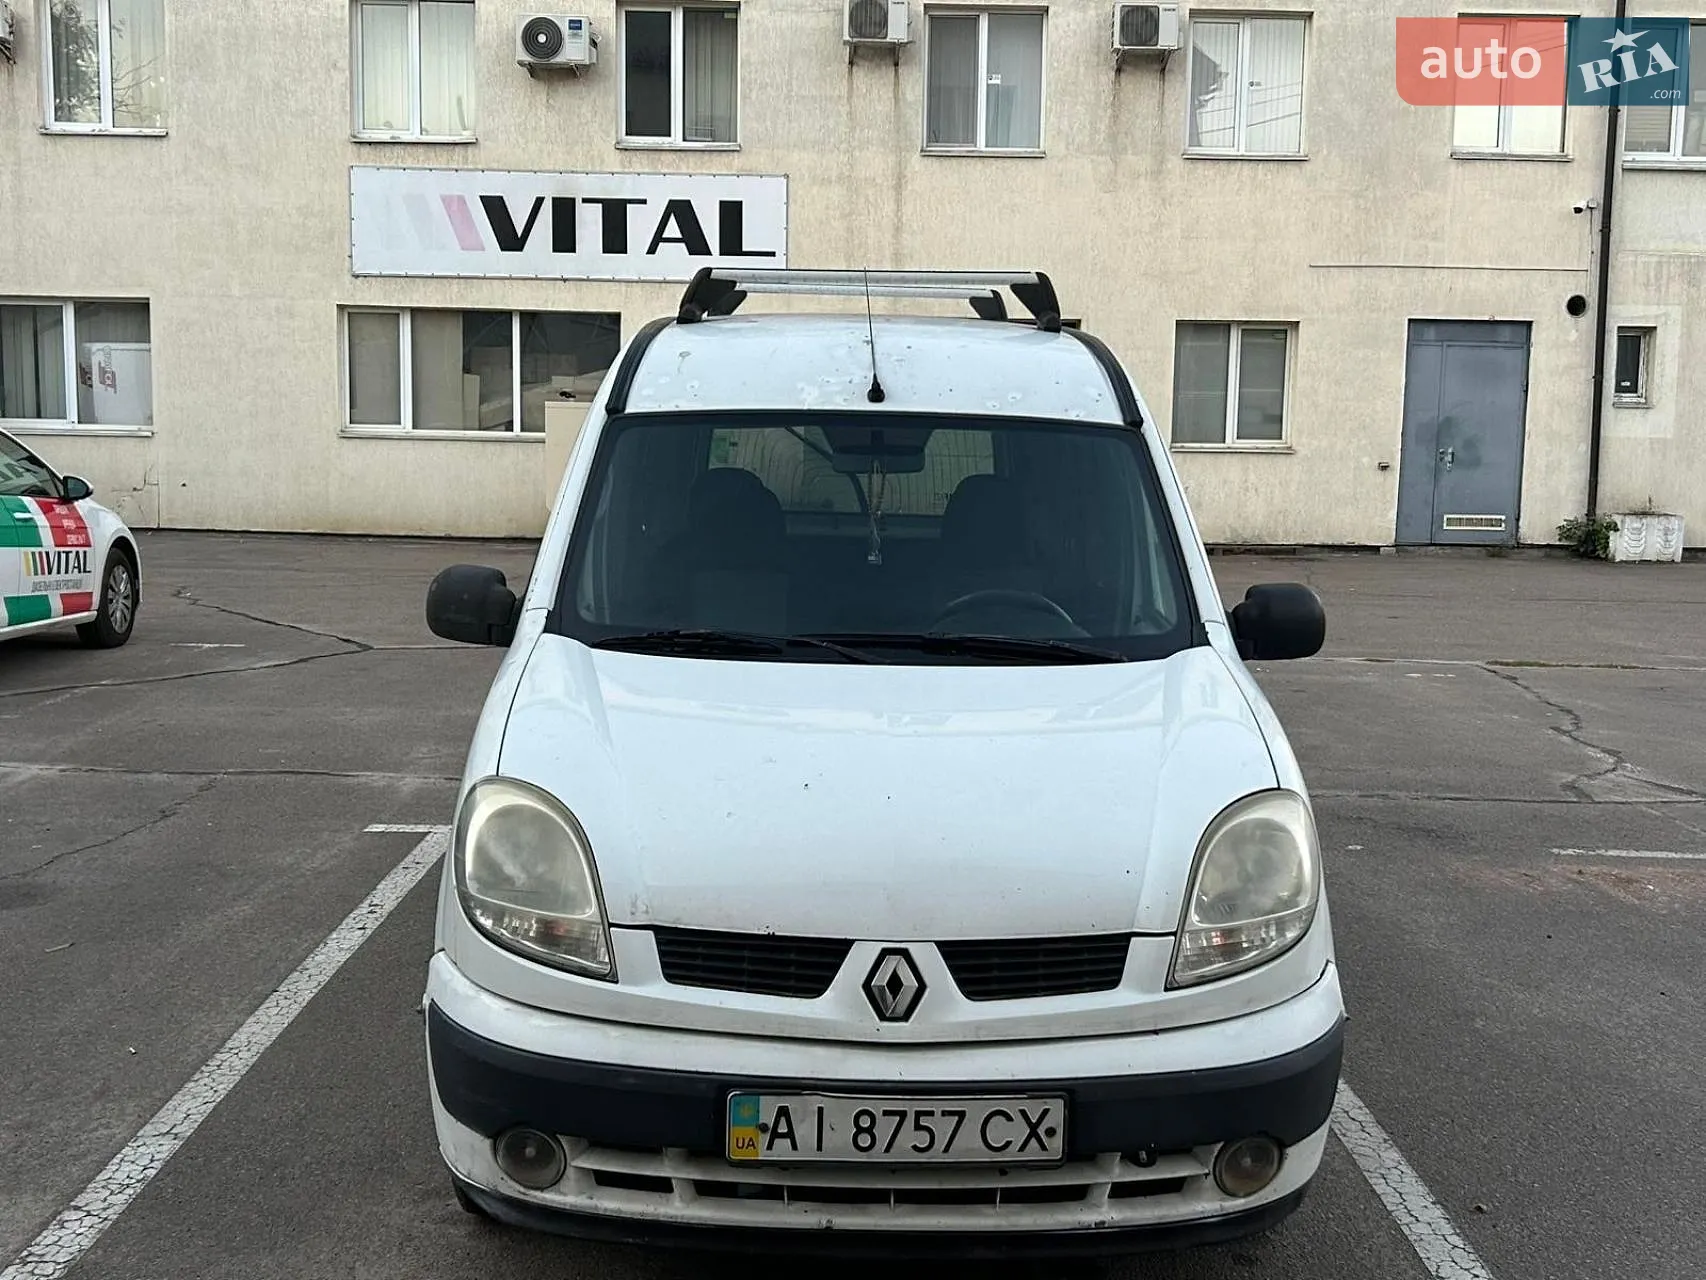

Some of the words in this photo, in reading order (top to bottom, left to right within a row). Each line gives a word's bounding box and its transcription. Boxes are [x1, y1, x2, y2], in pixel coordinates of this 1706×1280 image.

[479, 194, 777, 258] VITAL
[45, 550, 92, 575] VITAL
[735, 1136, 757, 1150] UA
[851, 1107, 967, 1154] 8757
[979, 1107, 1051, 1154] CX
